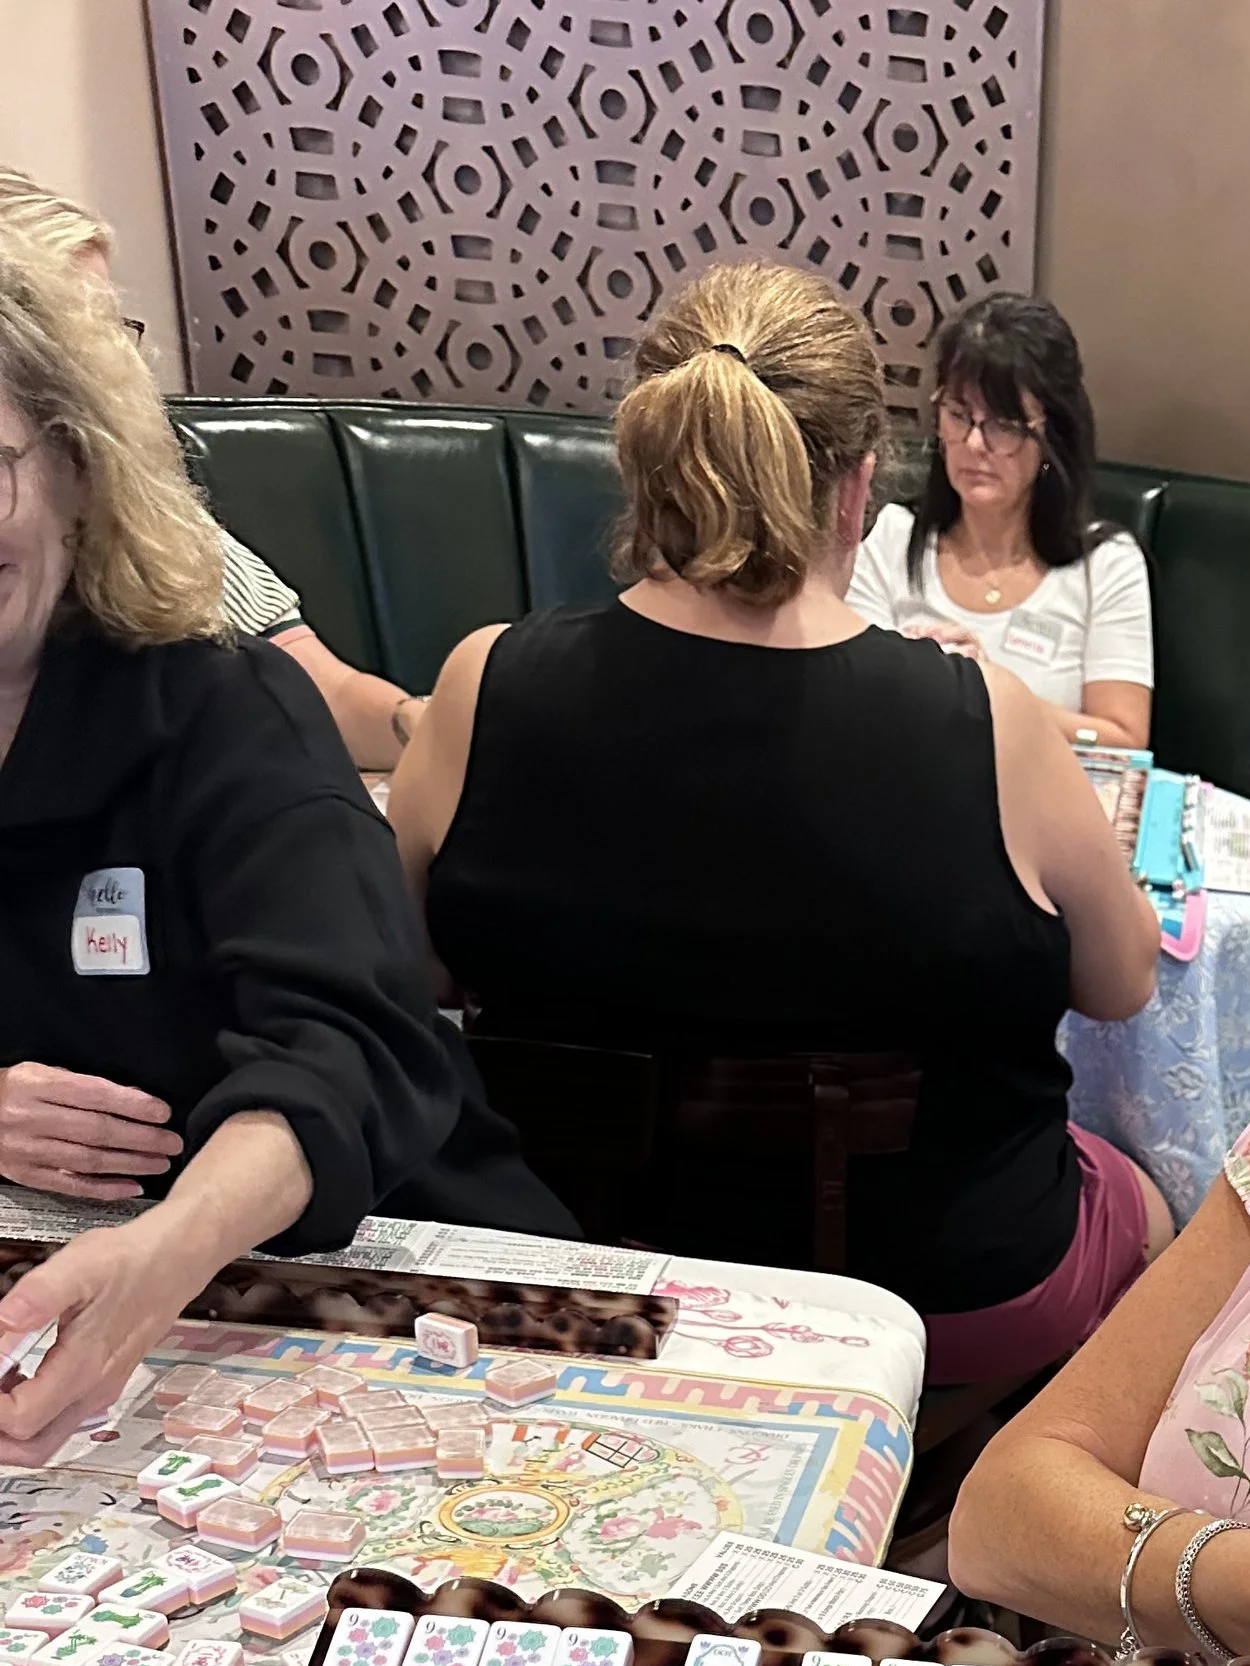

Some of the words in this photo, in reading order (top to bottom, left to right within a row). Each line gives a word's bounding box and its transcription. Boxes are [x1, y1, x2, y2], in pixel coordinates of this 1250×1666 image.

[349, 1613, 360, 1627] 9
[425, 1620, 436, 1634] 9
[496, 1626, 507, 1640] 9
[568, 1633, 579, 1647] 9
